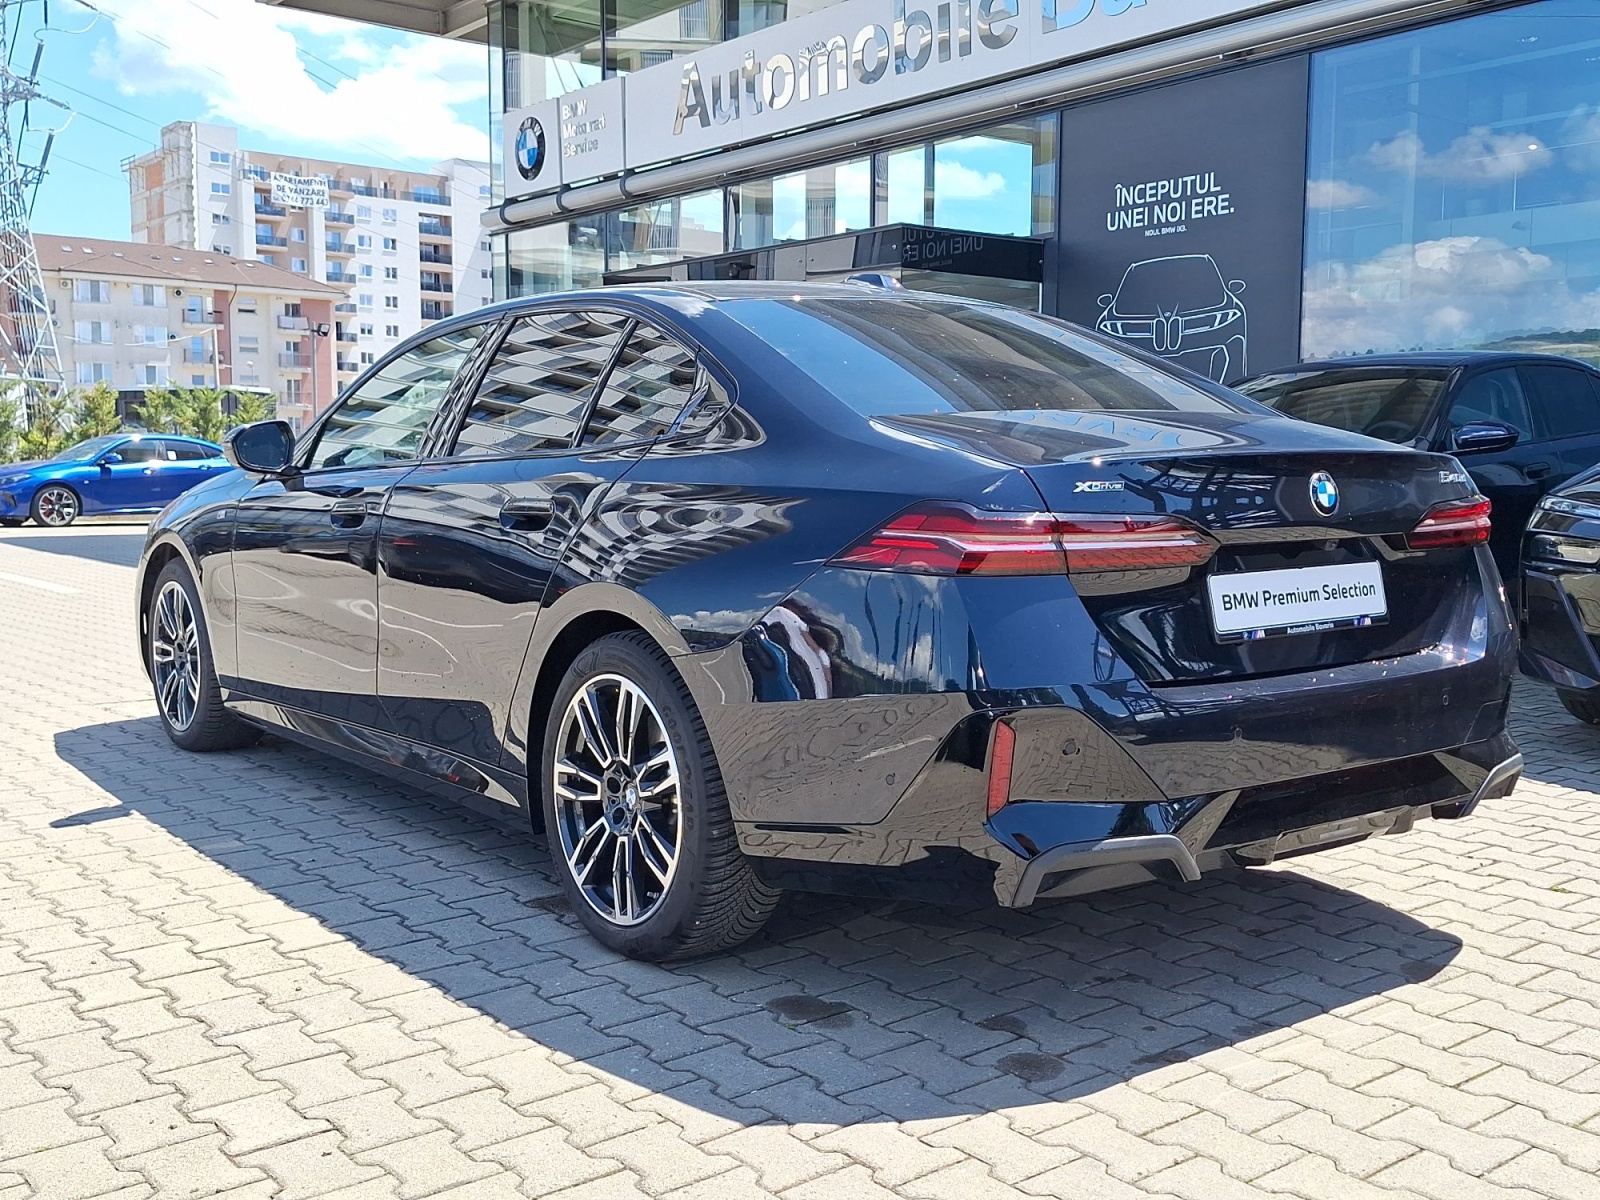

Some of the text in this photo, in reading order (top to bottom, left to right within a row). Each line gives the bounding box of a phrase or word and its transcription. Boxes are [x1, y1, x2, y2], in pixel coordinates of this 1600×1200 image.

[673, 0, 1019, 135] Automobile
[563, 139, 599, 158] Service
[276, 184, 286, 193] DE
[1114, 172, 1222, 208] ÎNCEPUTUL
[1106, 193, 1235, 231] UNEI NOI ERE.
[1161, 226, 1176, 235] BMW
[1221, 581, 1376, 611] BMW Premium Selection
[1286, 624, 1315, 635] Automobile
